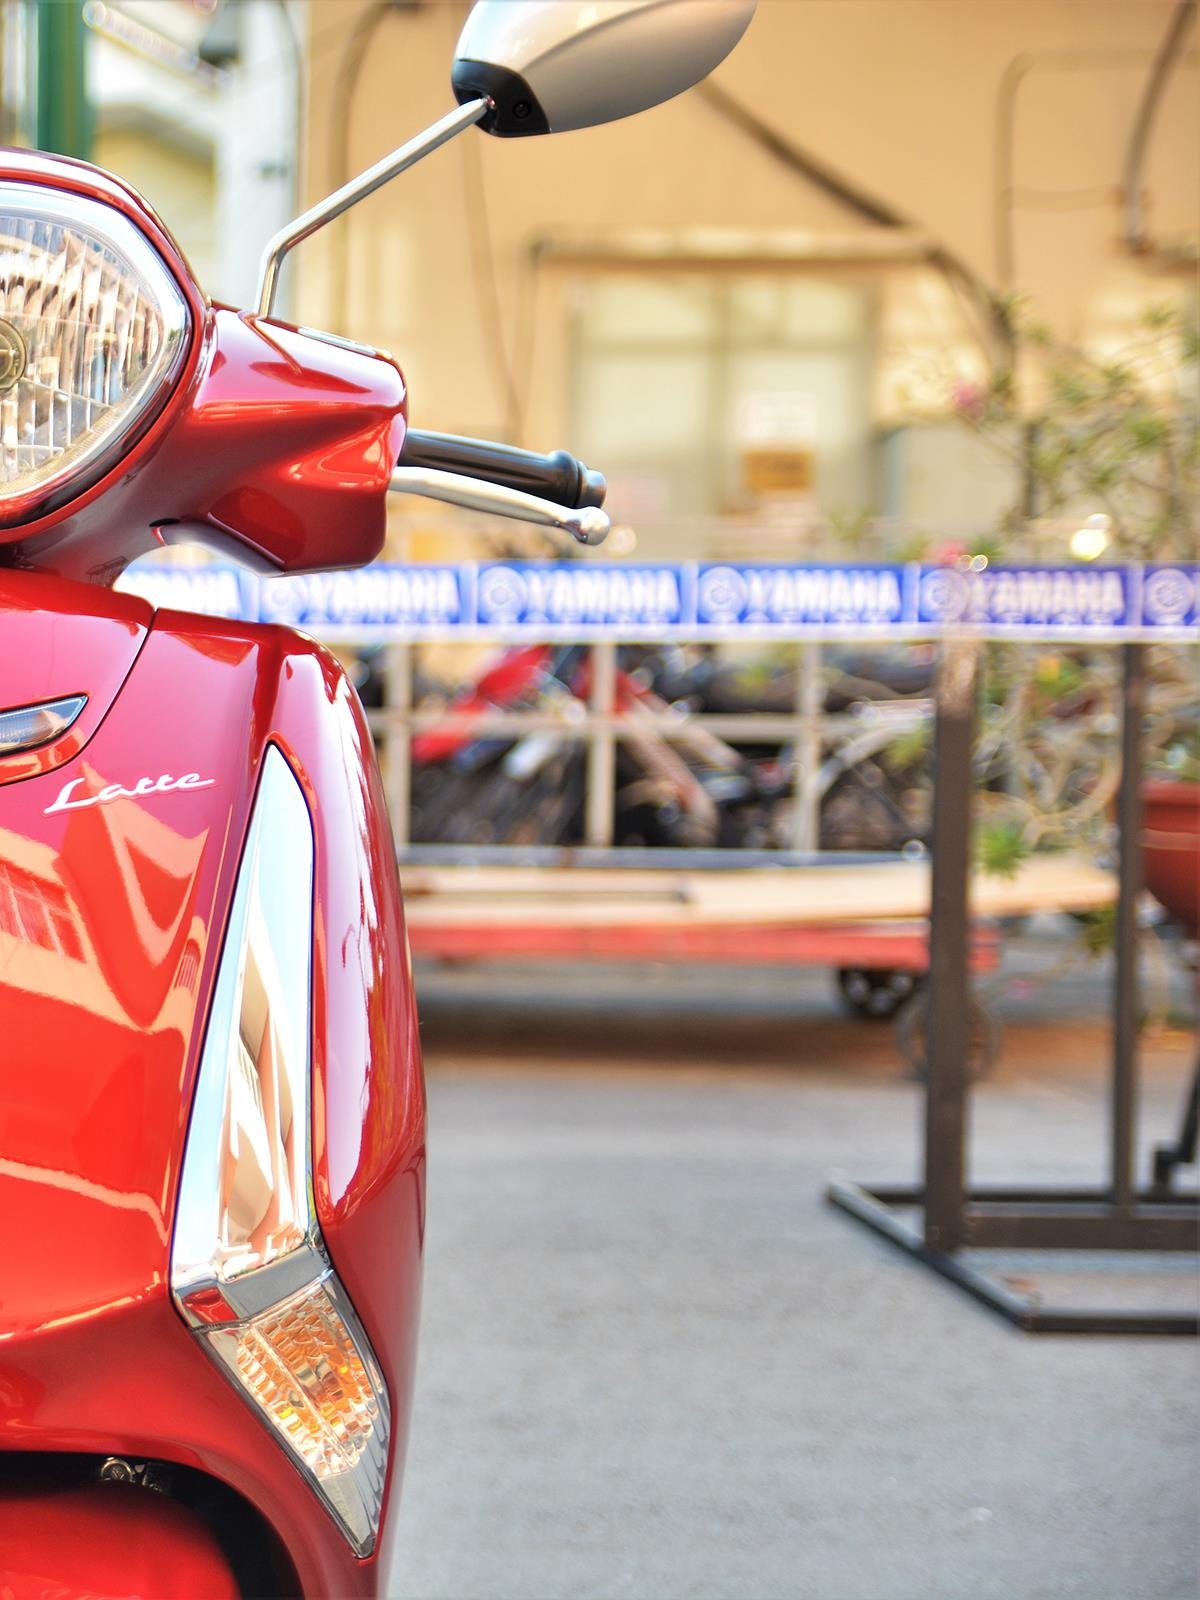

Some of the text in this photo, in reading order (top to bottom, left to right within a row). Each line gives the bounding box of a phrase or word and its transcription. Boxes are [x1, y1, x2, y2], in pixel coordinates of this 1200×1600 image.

[527, 569, 681, 619] YAMAHA
[744, 569, 902, 620] YAMAHA
[966, 570, 1126, 622] YAMAHA
[43, 772, 216, 814] Latte
